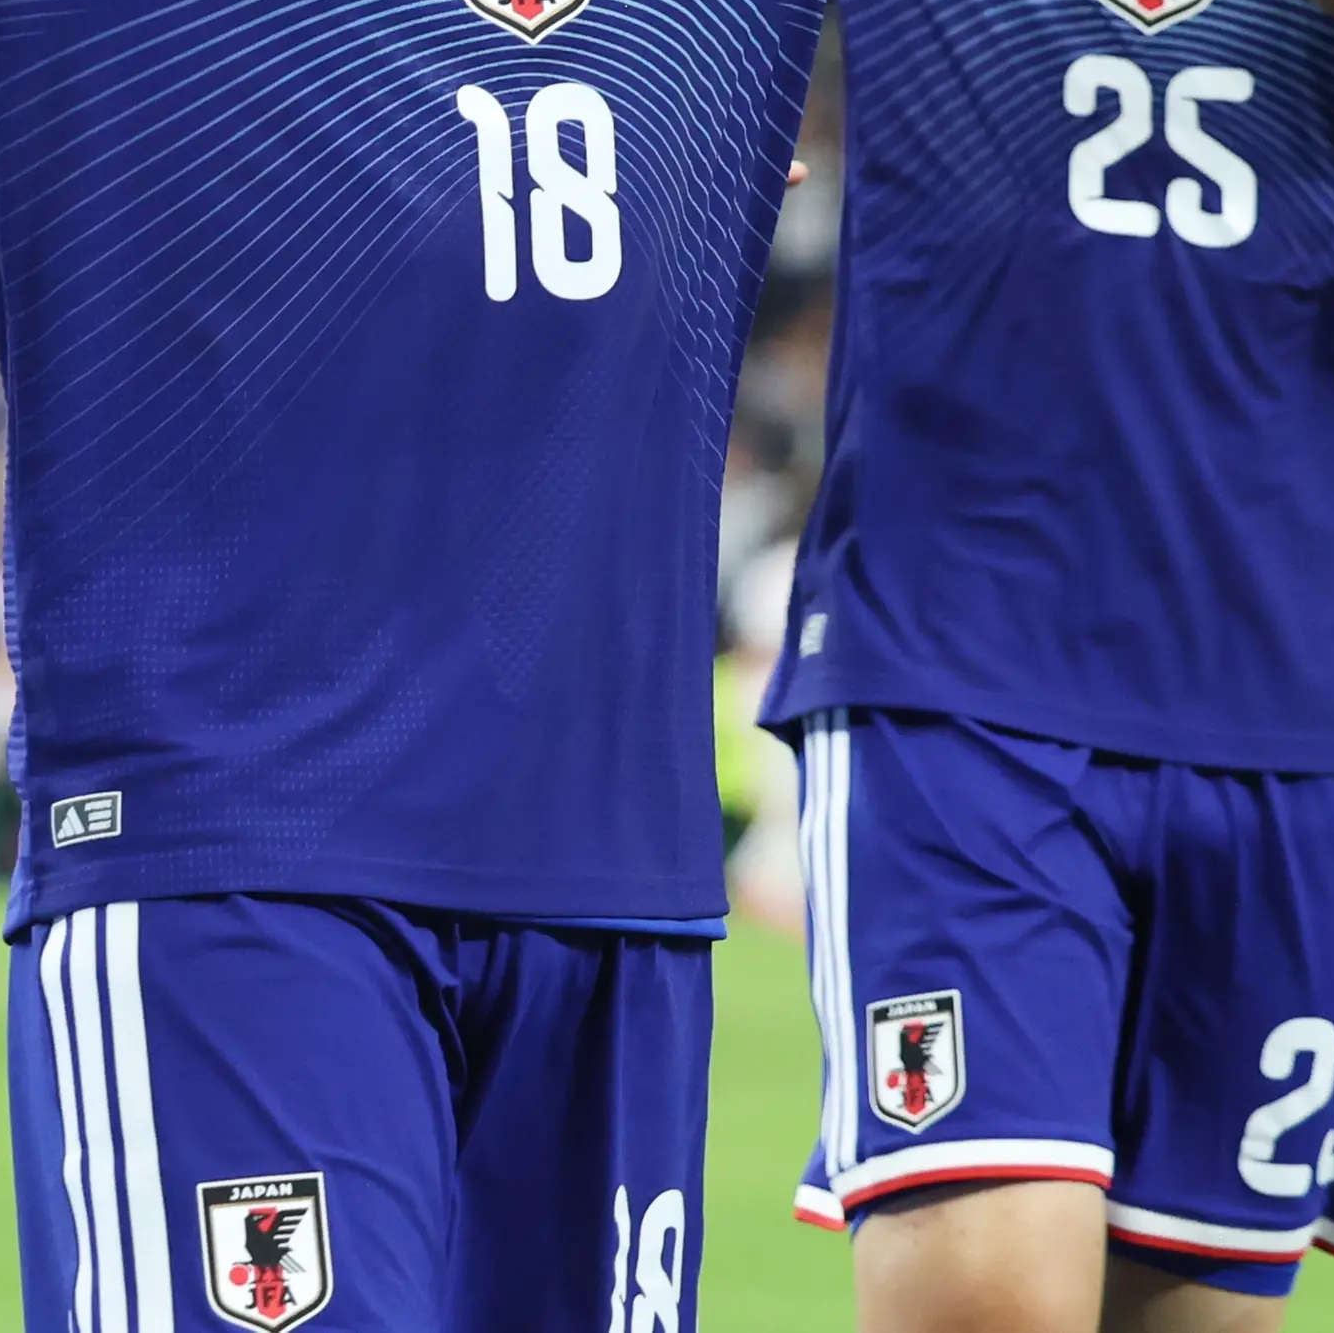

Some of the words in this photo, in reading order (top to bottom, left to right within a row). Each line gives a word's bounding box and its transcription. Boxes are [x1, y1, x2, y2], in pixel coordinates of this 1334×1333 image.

[456, 82, 622, 302] 18
[1063, 54, 1258, 248] 25
[229, 1182, 293, 1201] JAPAN
[245, 1286, 297, 1309] JFA
